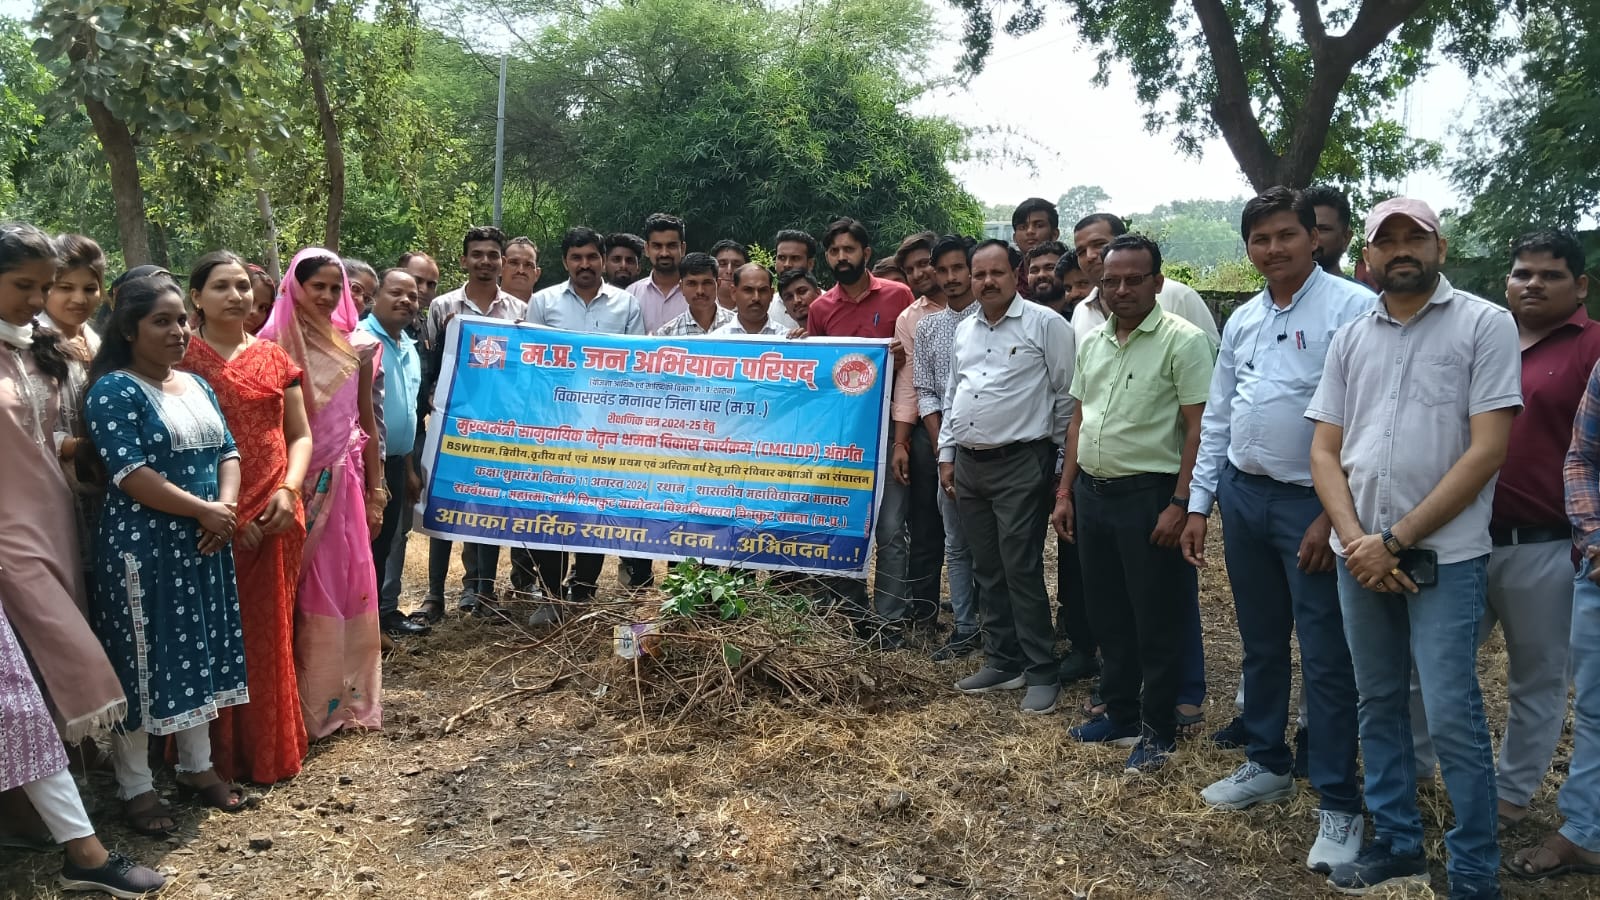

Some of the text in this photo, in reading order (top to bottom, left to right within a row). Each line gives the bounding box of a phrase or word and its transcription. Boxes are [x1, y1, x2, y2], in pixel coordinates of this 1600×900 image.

[520, 343, 576, 370] म.प्र.
[581, 346, 629, 373] जन
[632, 346, 737, 380] अभियान
[741, 351, 819, 391] परिषद्
[554, 387, 617, 406] विकासखंड
[619, 394, 664, 409] मनावर
[665, 394, 698, 411] जिला
[699, 399, 723, 413] धार
[607, 411, 716, 434] शैक्षणिक सत्र 2024-25 हेतु
[456, 419, 865, 463] मुख्यमंत्री सामुदायिक नेतृत्व क्षमता विकास कार्यक्रम (CMCLDP) अंतर्गत
[557, 451, 572, 462] वर्ष
[574, 453, 588, 464] एवं
[592, 455, 617, 466] MSW
[619, 458, 641, 468] प्रथम
[643, 459, 657, 470] एवं
[658, 459, 691, 472] अन्तिम
[692, 461, 706, 473] वर्ष
[723, 464, 742, 475] प्रति
[777, 468, 814, 480] कक्षाओं
[816, 472, 831, 481] का
[832, 471, 870, 485] संचालन
[474, 465, 501, 479] कक्षा
[502, 467, 540, 483] शुभारंभ
[541, 469, 577, 486] दिनांक
[579, 476, 589, 486] 11
[590, 476, 625, 490] अगस्त
[625, 479, 648, 491] 2024
[656, 482, 685, 493] स्थान
[695, 484, 744, 499] शासकीय
[745, 486, 810, 505] महाविद्यालय
[812, 493, 850, 507] मनावर
[435, 508, 509, 531] आपका
[511, 514, 577, 536] हार्दिक
[508, 490, 546, 502] महात्मा
[776, 511, 809, 524] सतना
